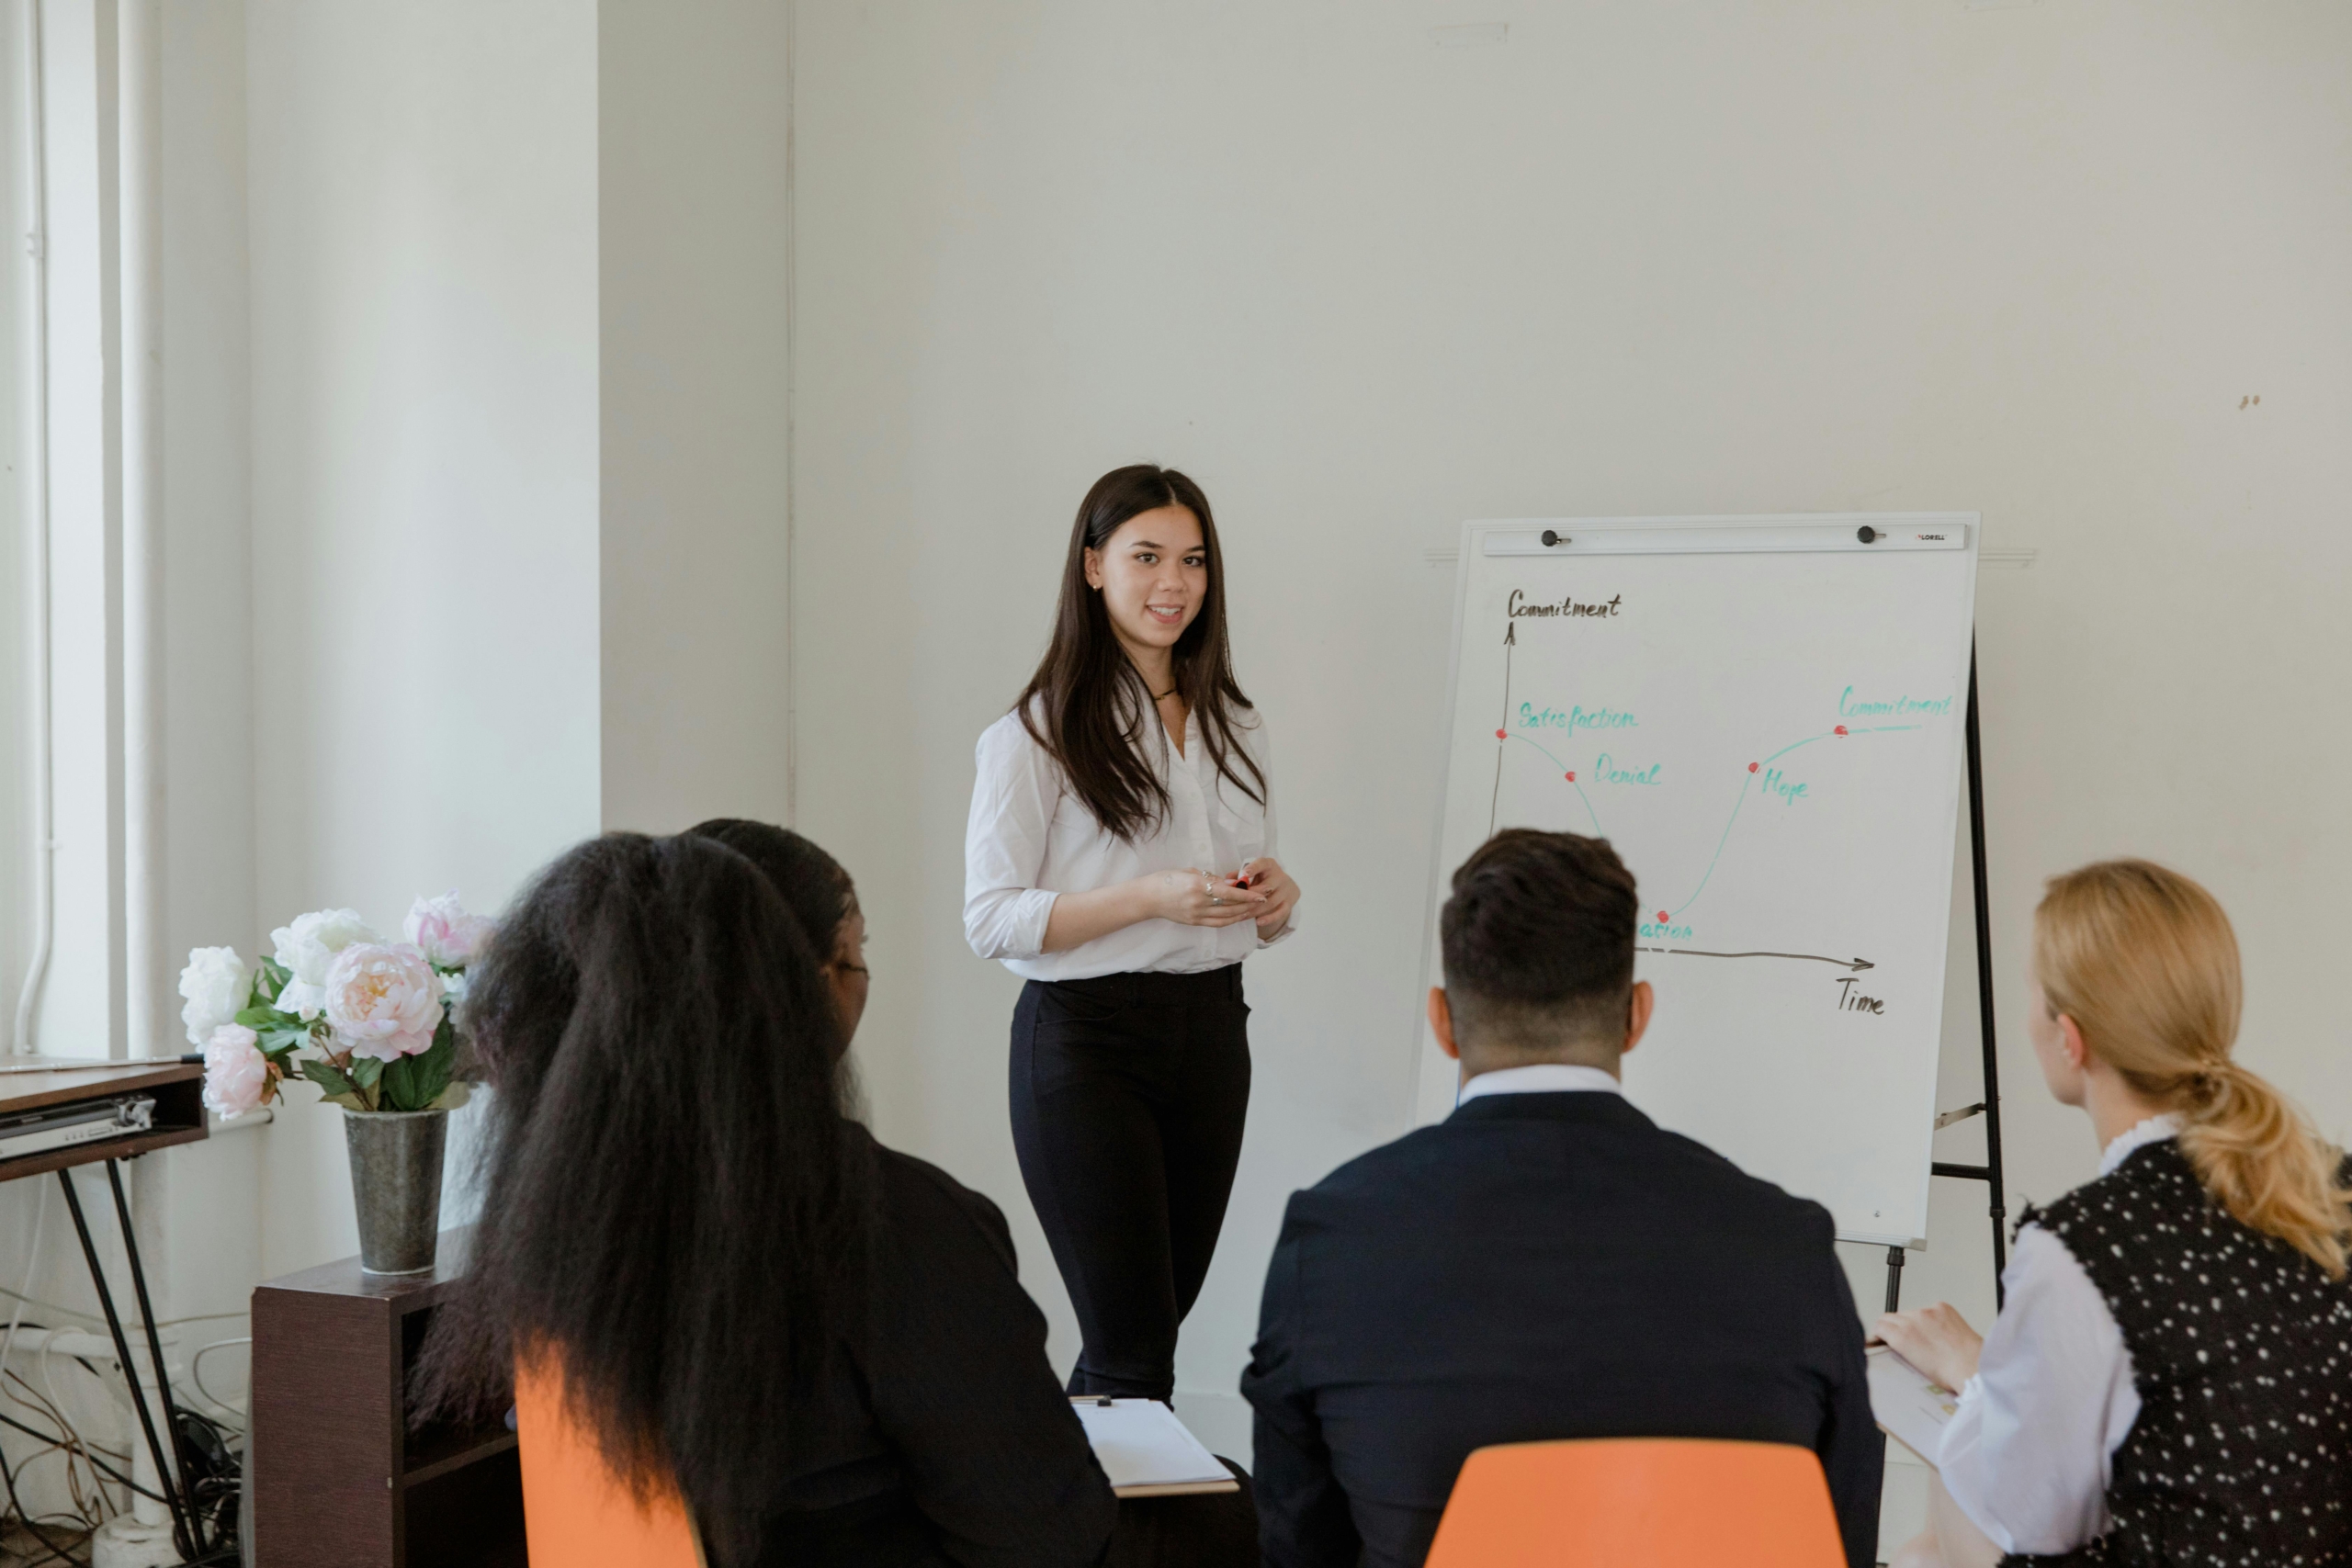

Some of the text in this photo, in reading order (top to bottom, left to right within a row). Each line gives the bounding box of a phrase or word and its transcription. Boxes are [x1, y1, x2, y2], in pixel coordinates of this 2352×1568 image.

[1508, 589, 1622, 618] Commitment
[1838, 684, 1953, 717] Commitment
[1519, 702, 1639, 739] Satisfaction
[1595, 752, 1661, 785] Denial
[1762, 768, 1809, 807] Hope
[1637, 922, 1693, 942] ation
[1836, 977, 1884, 1015] Time
